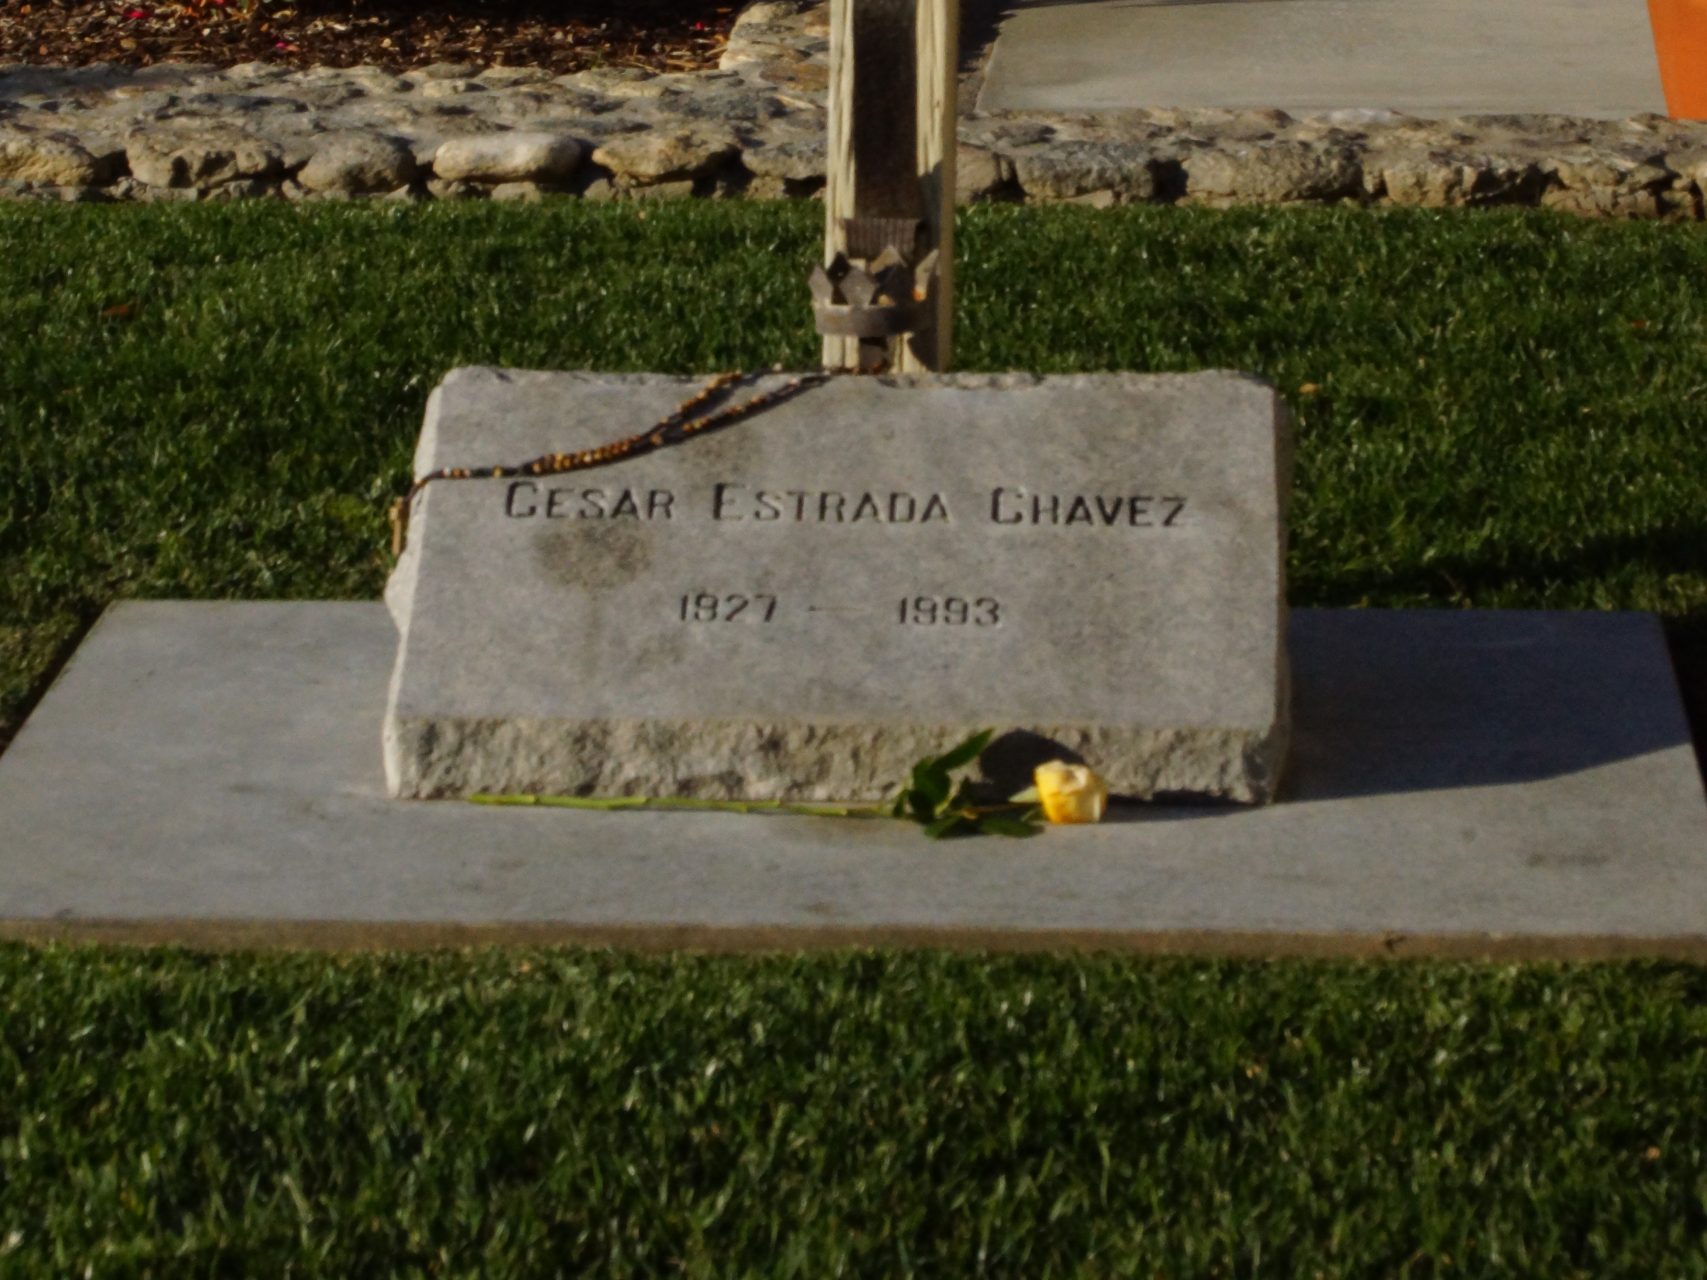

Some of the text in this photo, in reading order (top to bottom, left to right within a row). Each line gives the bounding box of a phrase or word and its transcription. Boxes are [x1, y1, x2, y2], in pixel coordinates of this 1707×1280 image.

[505, 481, 1188, 528] CESAR ESTRADA CHAVEZ
[679, 593, 777, 622] 1927
[898, 595, 1001, 627] 1993
